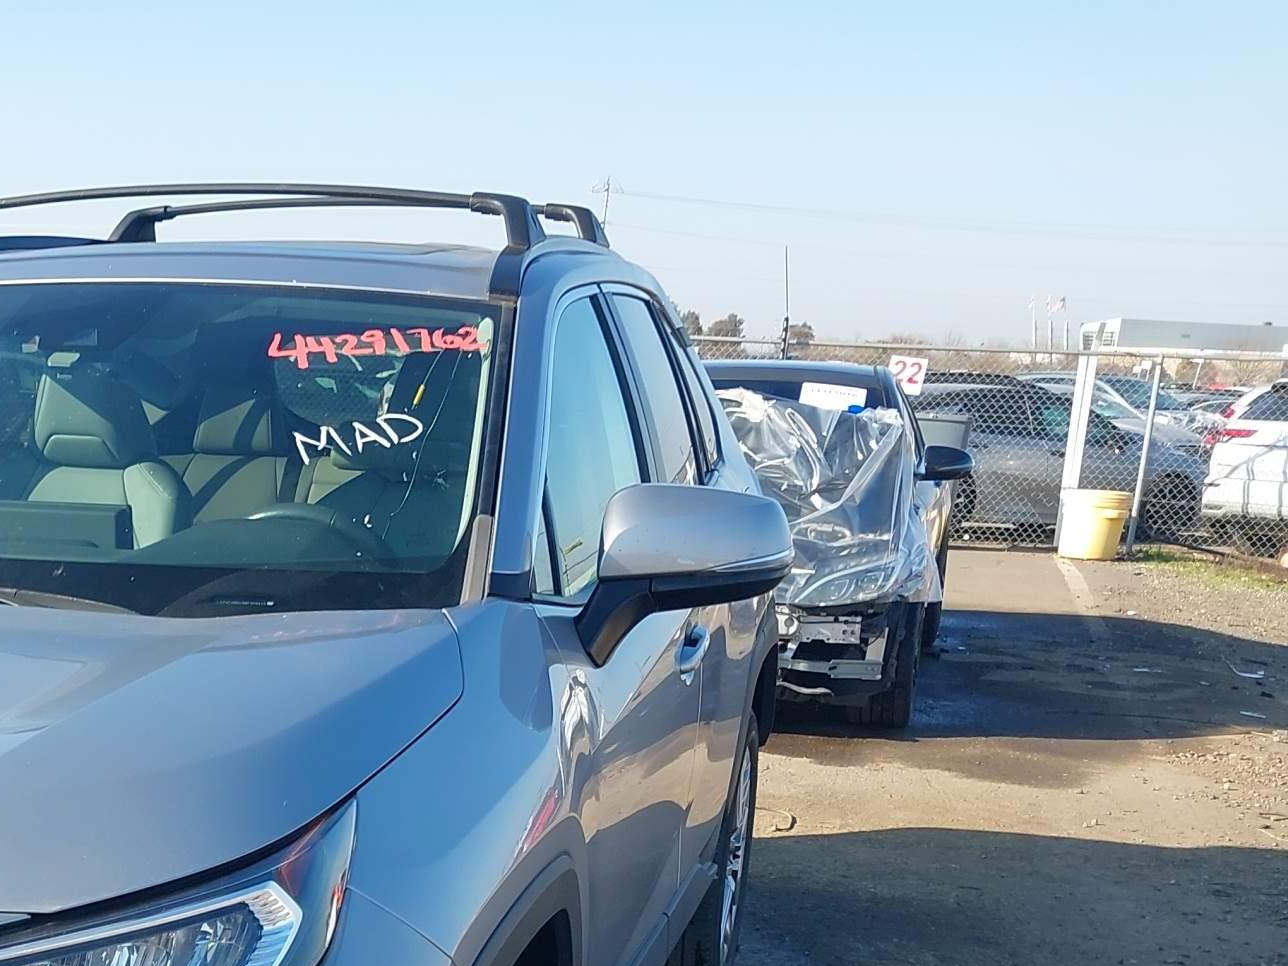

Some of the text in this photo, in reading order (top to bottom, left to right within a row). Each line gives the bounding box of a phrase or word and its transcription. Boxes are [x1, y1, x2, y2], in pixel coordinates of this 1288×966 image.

[267, 325, 489, 369] 44291762
[894, 360, 923, 384] 22
[293, 413, 424, 465] MAD
